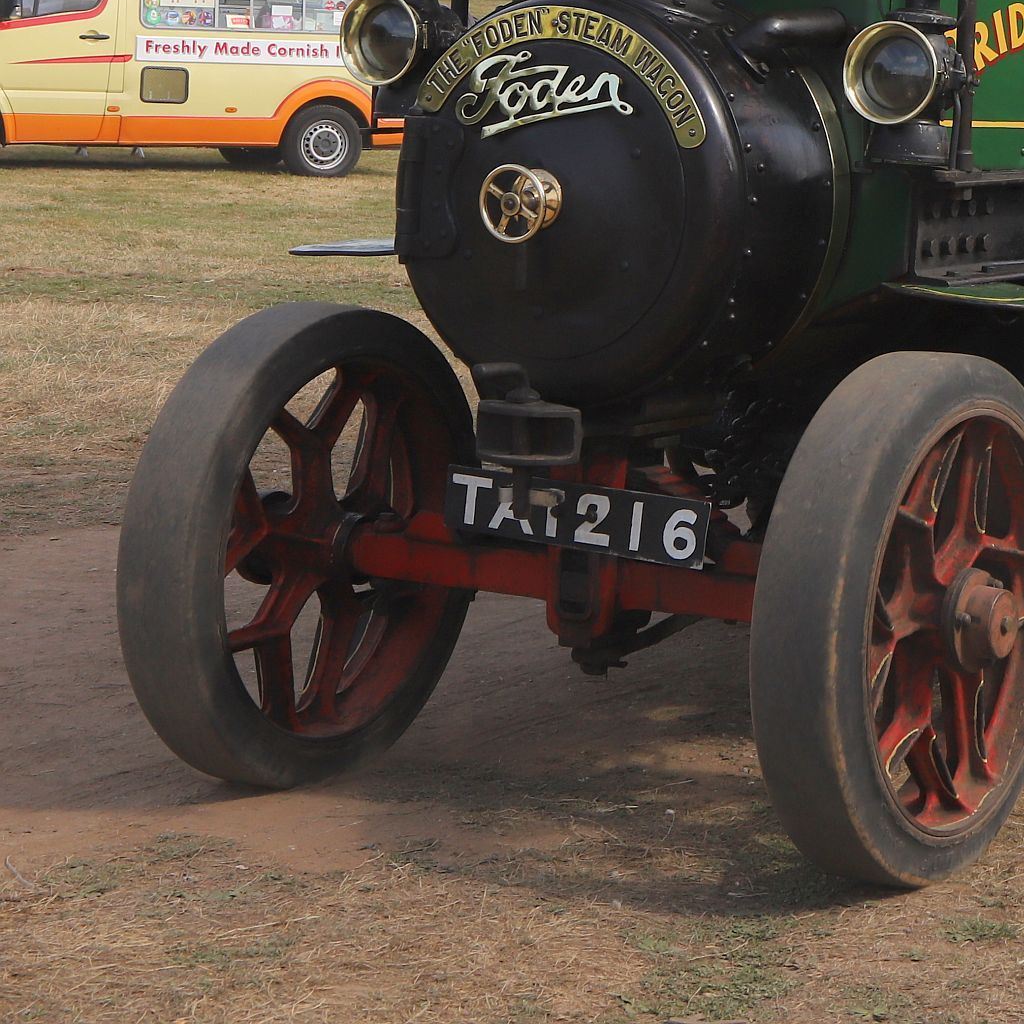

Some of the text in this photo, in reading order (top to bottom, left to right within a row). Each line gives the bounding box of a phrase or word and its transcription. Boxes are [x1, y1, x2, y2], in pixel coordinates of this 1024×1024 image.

[145, 40, 207, 58] Freshly
[214, 42, 260, 56] Made
[267, 43, 329, 58] Cornish
[426, 50, 468, 94] THE
[556, 11, 635, 57] STEAM
[632, 47, 696, 129] WAGON
[455, 50, 635, 139] Foden
